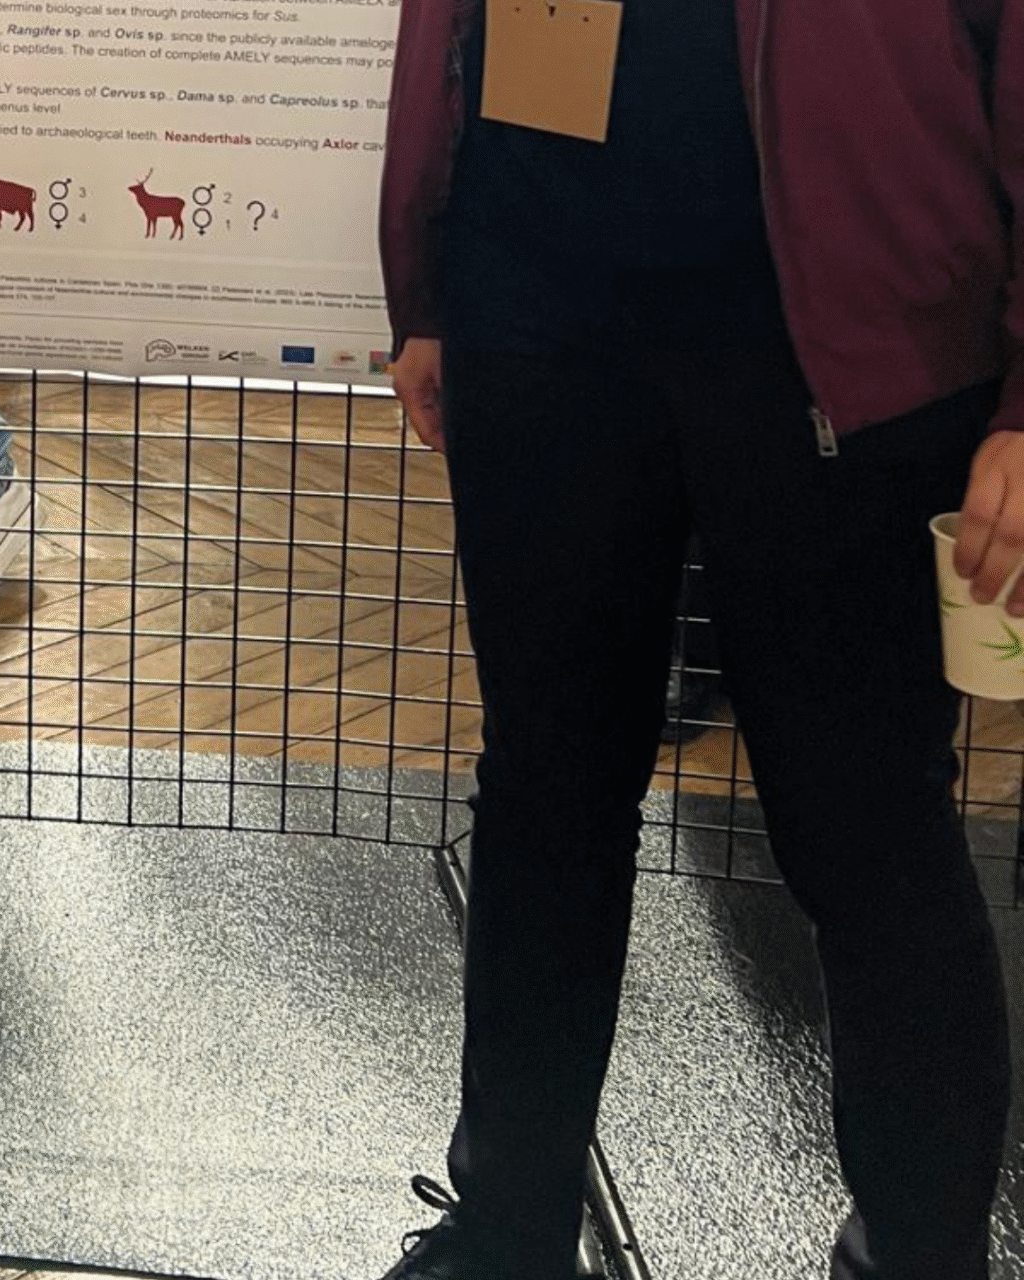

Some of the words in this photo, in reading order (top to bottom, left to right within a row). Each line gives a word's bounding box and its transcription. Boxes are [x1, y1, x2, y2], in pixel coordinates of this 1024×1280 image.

[163, 130, 252, 145] Neanderthals
[254, 136, 319, 151] occupying
[321, 137, 359, 150] Axlor
[78, 187, 87, 198] 3
[223, 191, 232, 204] 2
